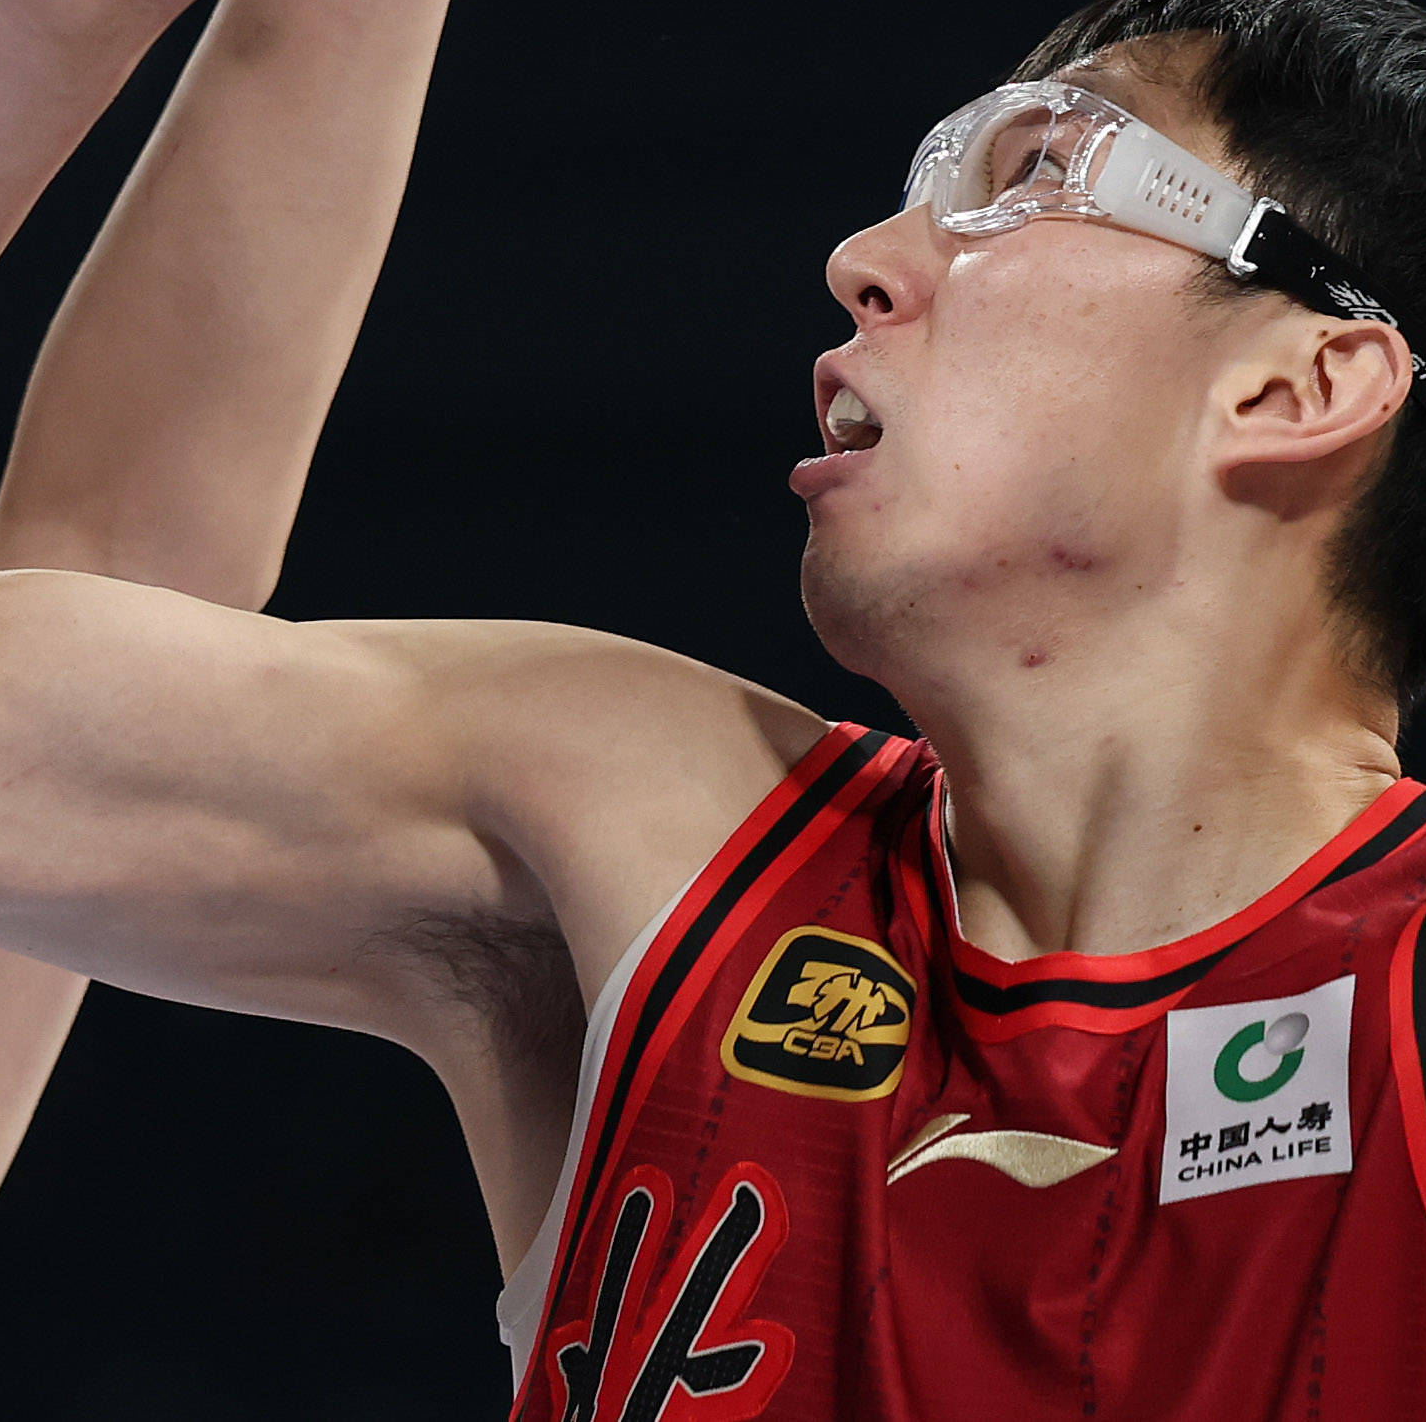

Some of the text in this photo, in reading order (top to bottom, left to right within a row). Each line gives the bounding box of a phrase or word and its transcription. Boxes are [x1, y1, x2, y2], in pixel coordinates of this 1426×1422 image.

[782, 1028, 865, 1067] CBA
[1180, 1101, 1333, 1161] 中国人寿
[1178, 1136, 1332, 1182] CHINA LIFE
